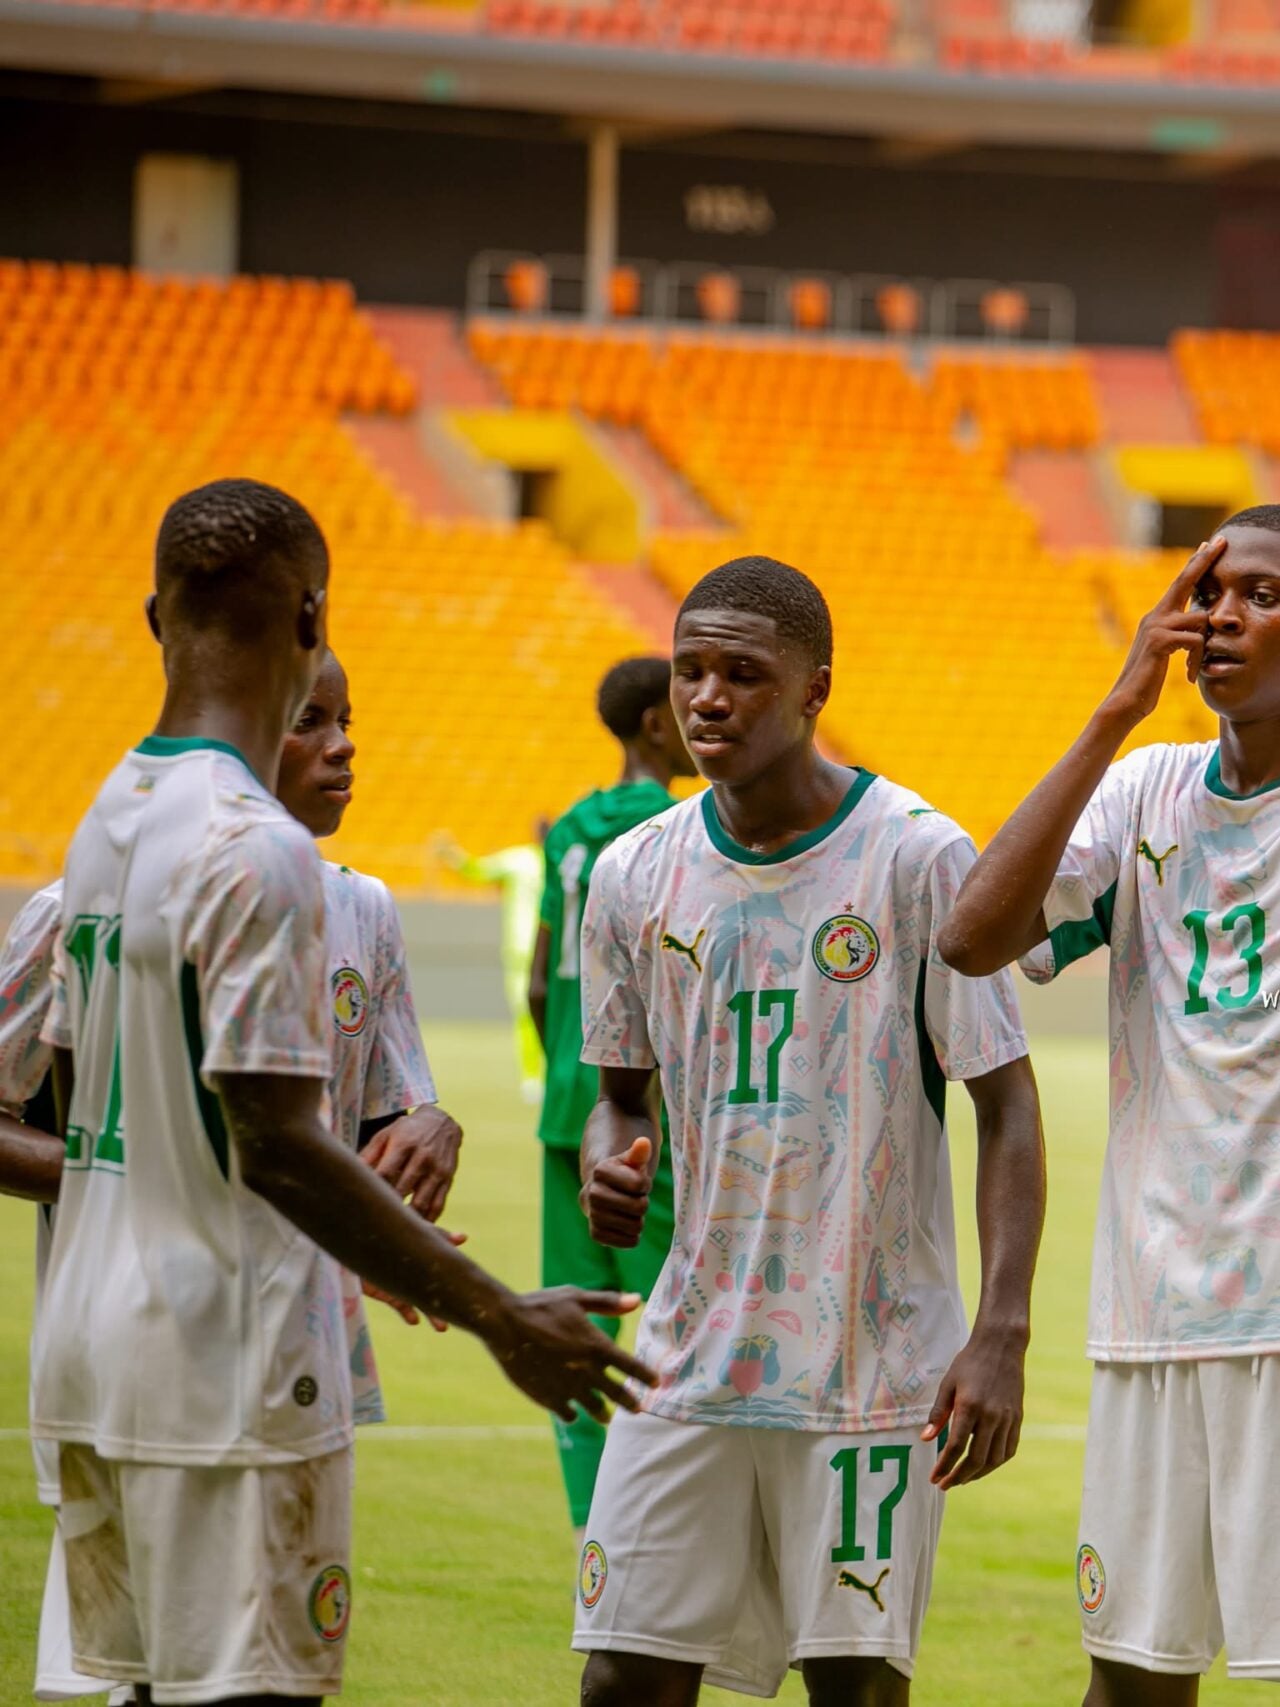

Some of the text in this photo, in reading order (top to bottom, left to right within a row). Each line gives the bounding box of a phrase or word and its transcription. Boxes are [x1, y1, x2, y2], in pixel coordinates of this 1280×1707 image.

[1182, 902, 1266, 1015] 13
[726, 989, 798, 1105] 17
[829, 1445, 913, 1563] 17
